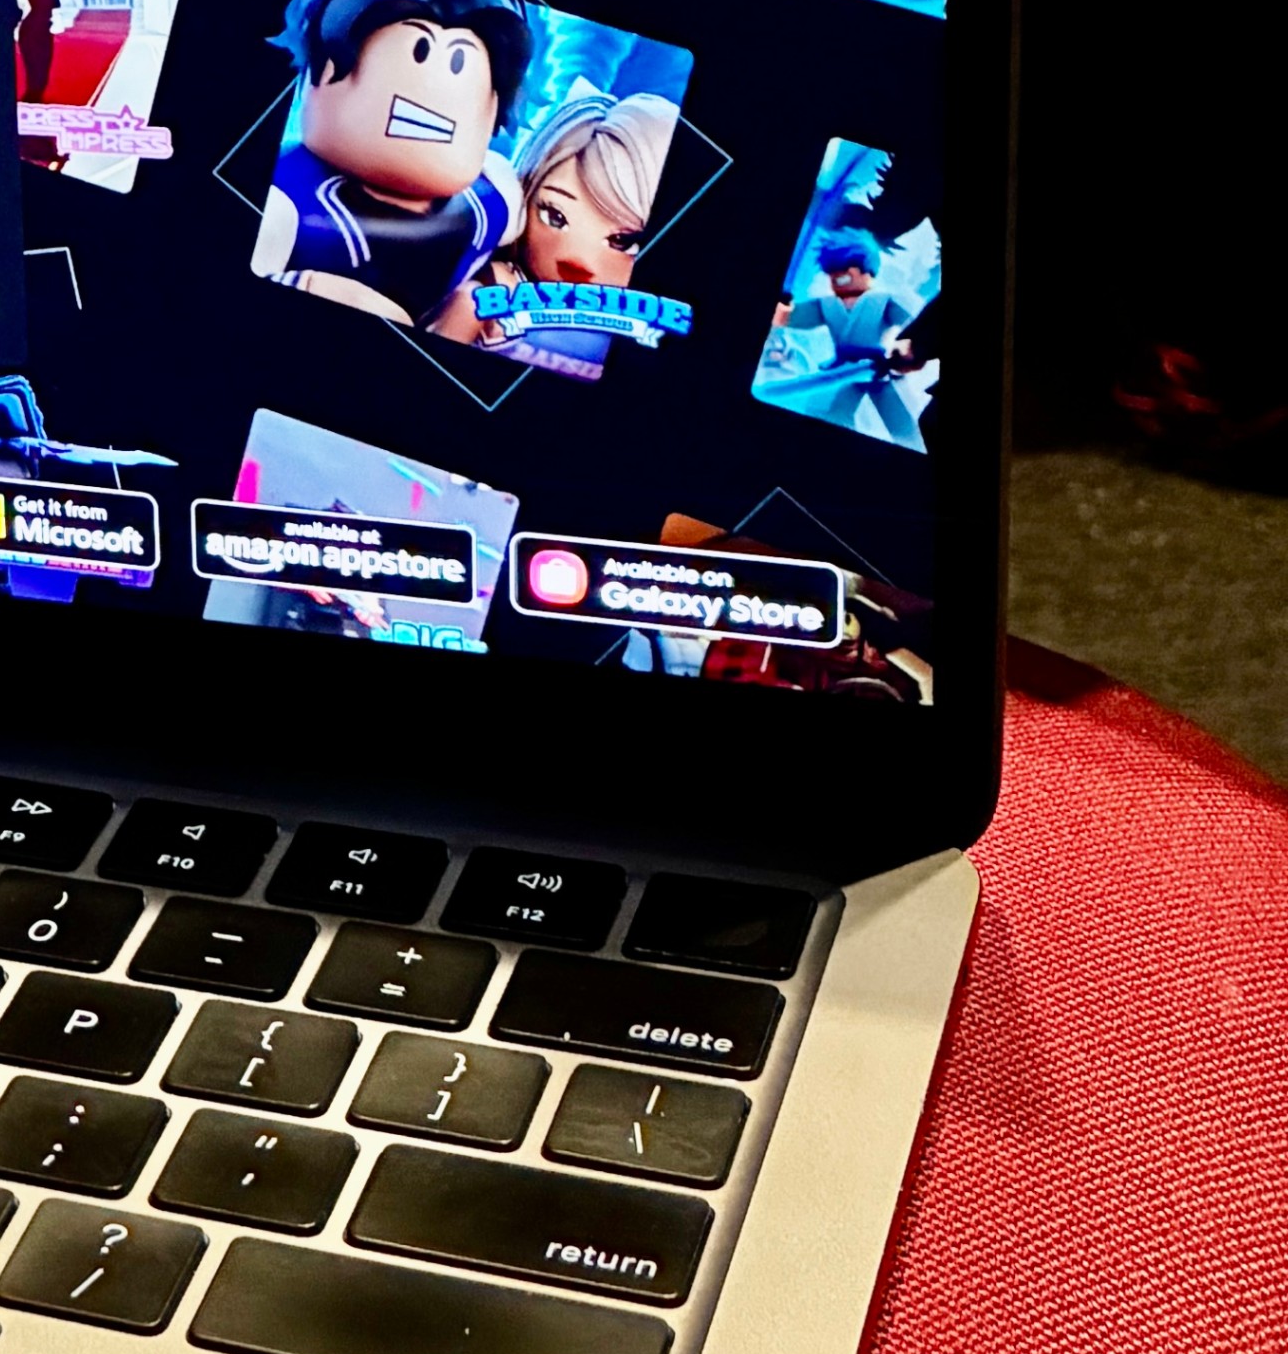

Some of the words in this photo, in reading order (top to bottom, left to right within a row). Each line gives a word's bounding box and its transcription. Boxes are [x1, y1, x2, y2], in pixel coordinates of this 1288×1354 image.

[474, 282, 692, 335] BAYSIDE
[13, 495, 45, 516] Get
[47, 498, 63, 517] it
[64, 500, 108, 521] from
[14, 517, 144, 556] Microsoft
[284, 521, 353, 543] available
[355, 527, 381, 546] at
[205, 530, 319, 574] amazon
[325, 544, 466, 583] appstore
[602, 557, 698, 585] Available
[702, 570, 733, 588] on
[600, 581, 724, 628] Galaxy
[730, 594, 824, 631] Store
[157, 854, 195, 870] F10
[329, 879, 364, 895] F11
[506, 905, 545, 922] F12
[626, 1022, 734, 1055] delete
[545, 1240, 658, 1280] return
